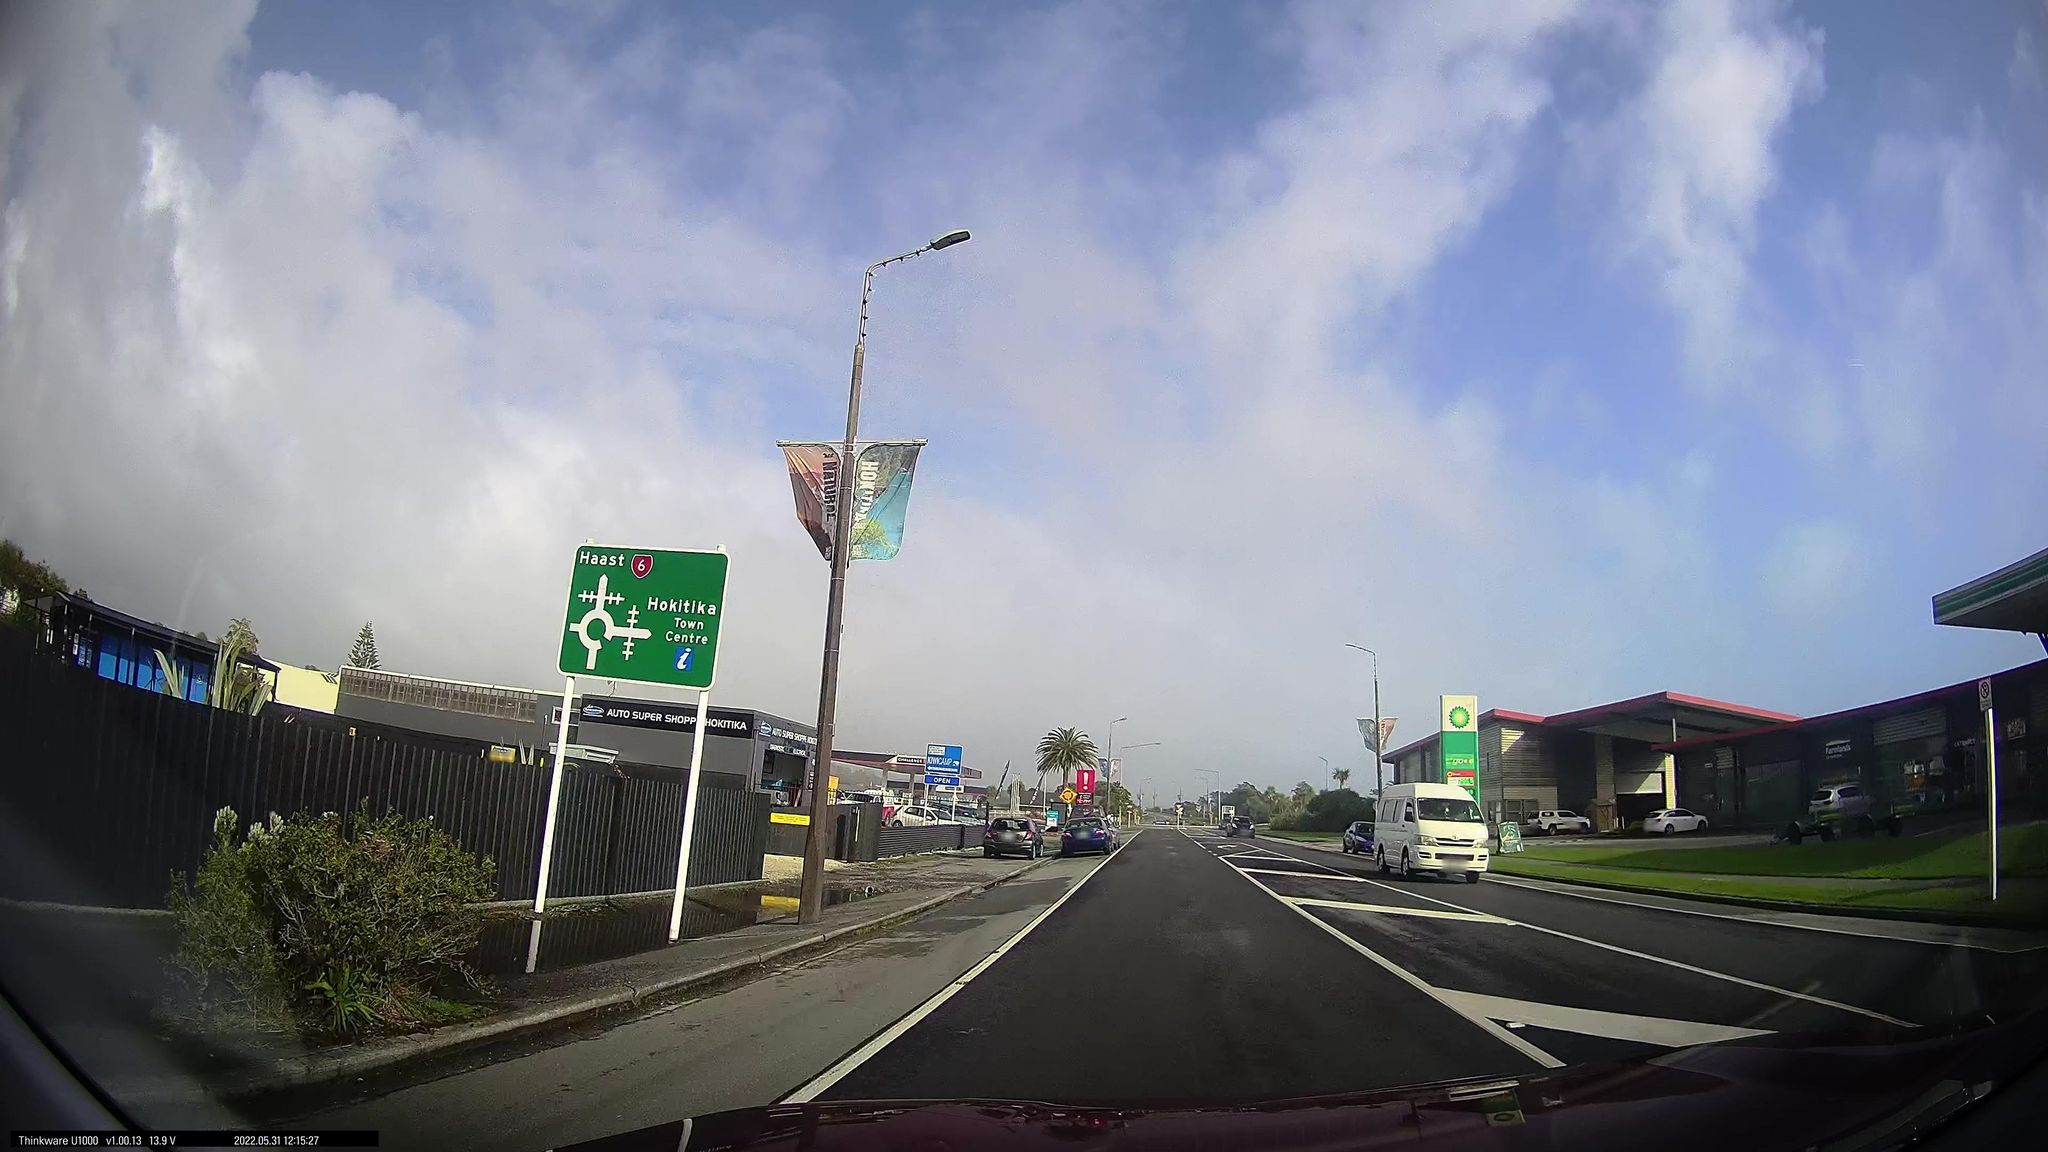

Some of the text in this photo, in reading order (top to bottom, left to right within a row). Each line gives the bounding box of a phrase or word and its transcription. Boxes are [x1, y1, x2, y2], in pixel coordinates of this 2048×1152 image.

[579, 551, 626, 567] Haast
[637, 559, 646, 572] 6
[647, 597, 717, 616] Hokitika
[674, 617, 704, 630] Town
[665, 631, 708, 645] Centre
[606, 708, 630, 719] AUTO
[632, 711, 663, 722] SUPER
[664, 714, 698, 725] SHOPP
[705, 718, 748, 731] HOKITIKA
